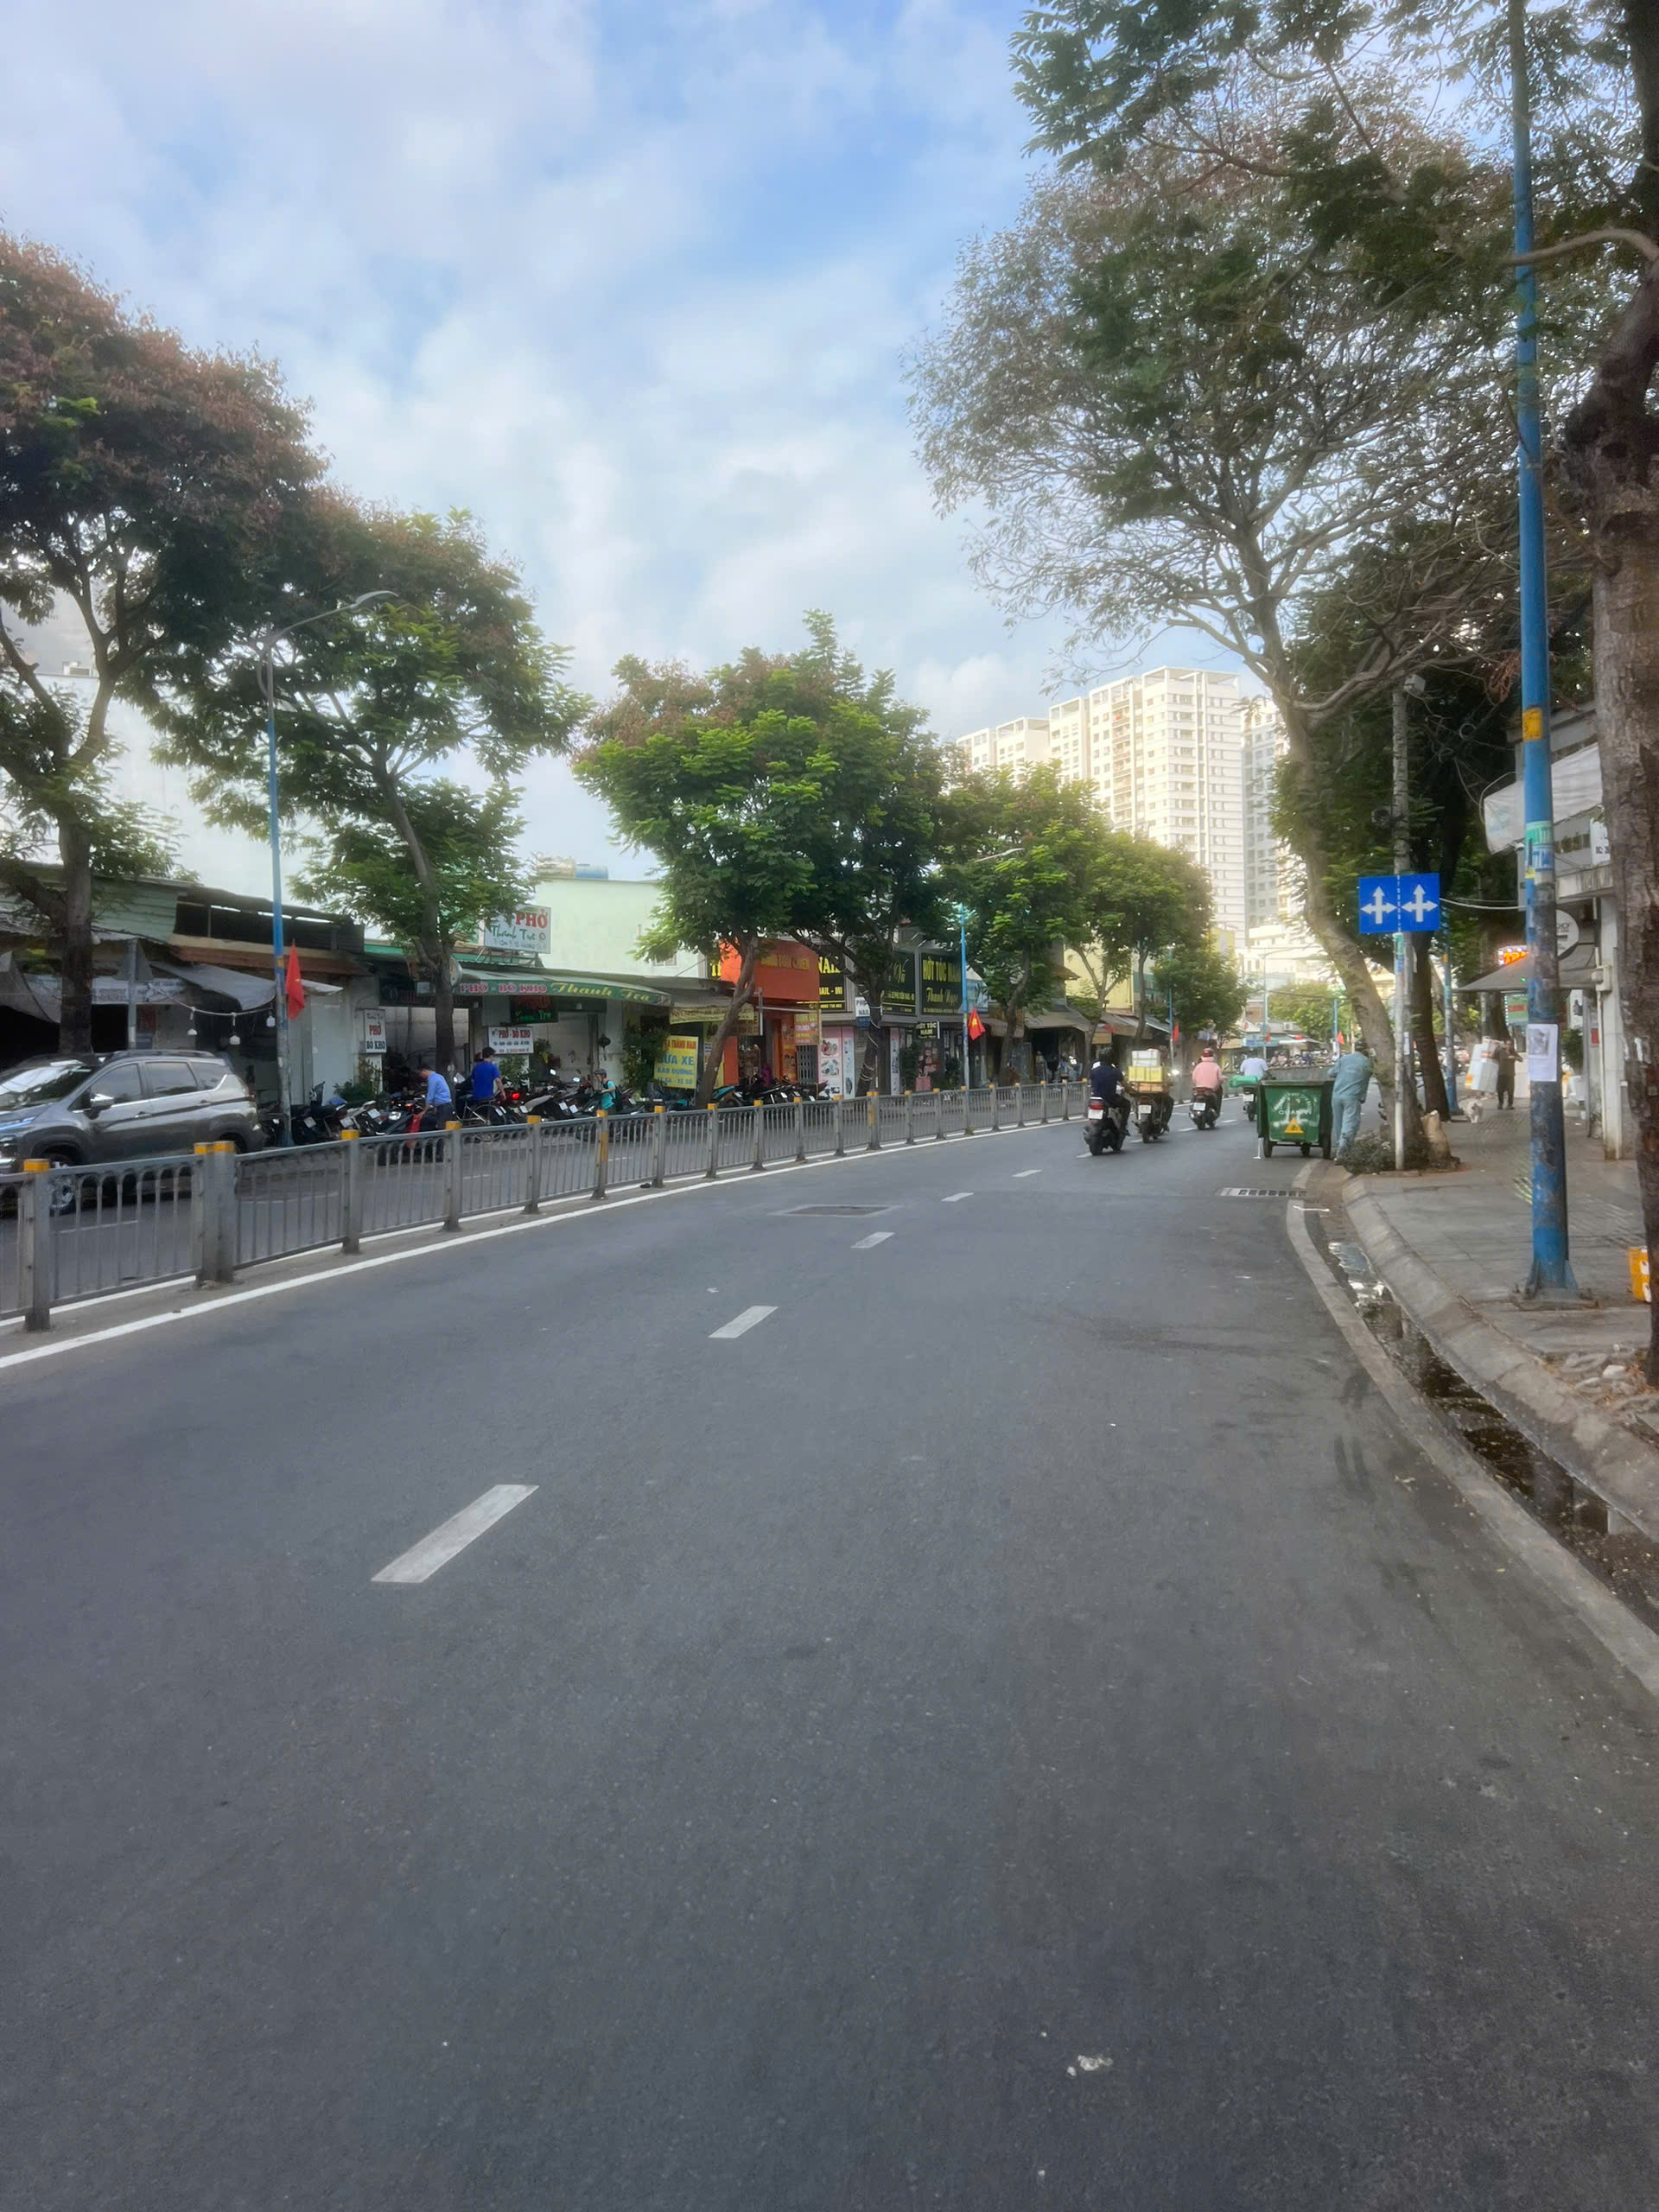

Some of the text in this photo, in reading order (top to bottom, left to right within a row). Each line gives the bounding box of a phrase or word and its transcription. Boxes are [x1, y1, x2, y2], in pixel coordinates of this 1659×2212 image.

[516, 908, 547, 929] PHỞ
[519, 983, 547, 994] KHO
[682, 1055, 694, 1065] XE
